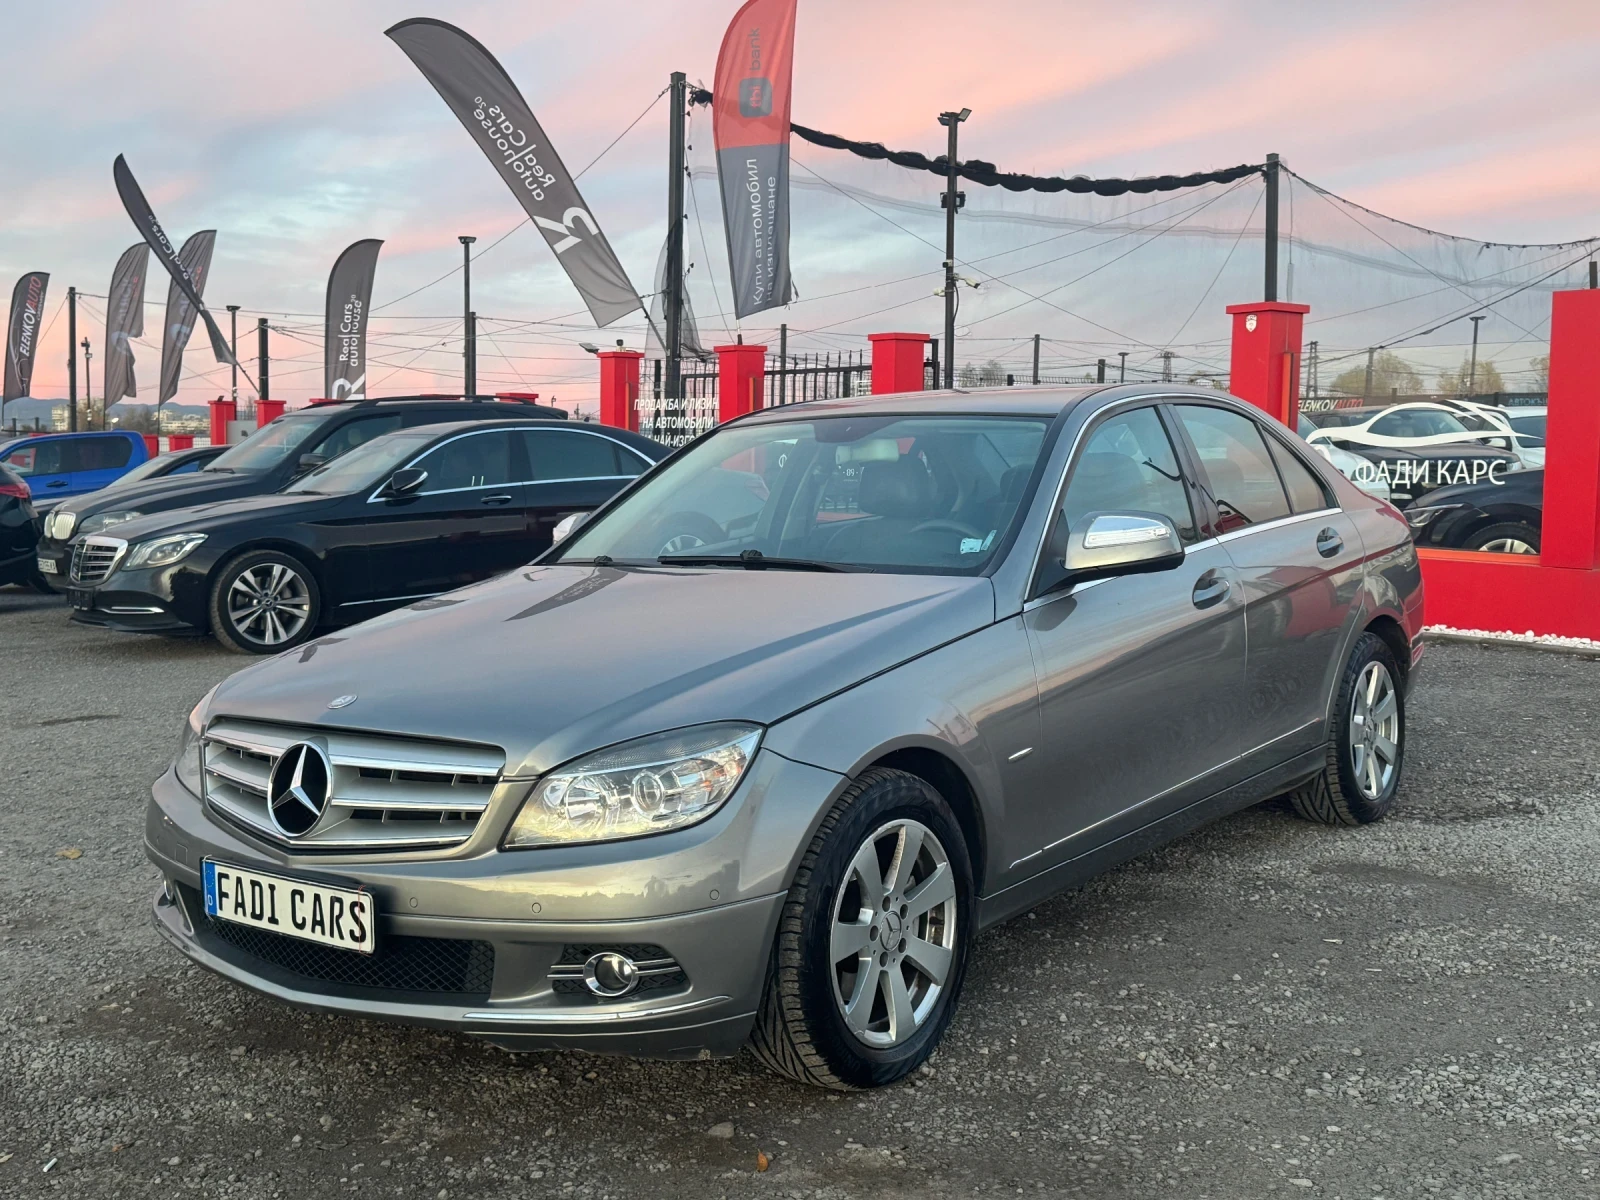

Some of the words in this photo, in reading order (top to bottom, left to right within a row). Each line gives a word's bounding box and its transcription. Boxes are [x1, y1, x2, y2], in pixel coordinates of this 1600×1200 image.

[748, 27, 761, 71] bank
[746, 158, 763, 259] автомобил
[753, 263, 765, 306] Купи
[340, 303, 353, 333] Cars
[338, 334, 352, 362] Real
[633, 398, 680, 411] ПРОДАЖБА
[681, 398, 689, 411] И
[642, 416, 654, 429] НА
[655, 416, 715, 429] АВТОМОБИЛИ
[1355, 459, 1430, 489] ФАДИ
[1437, 459, 1506, 486] КАРС
[217, 871, 280, 926] FADI
[290, 888, 367, 944] CARS
